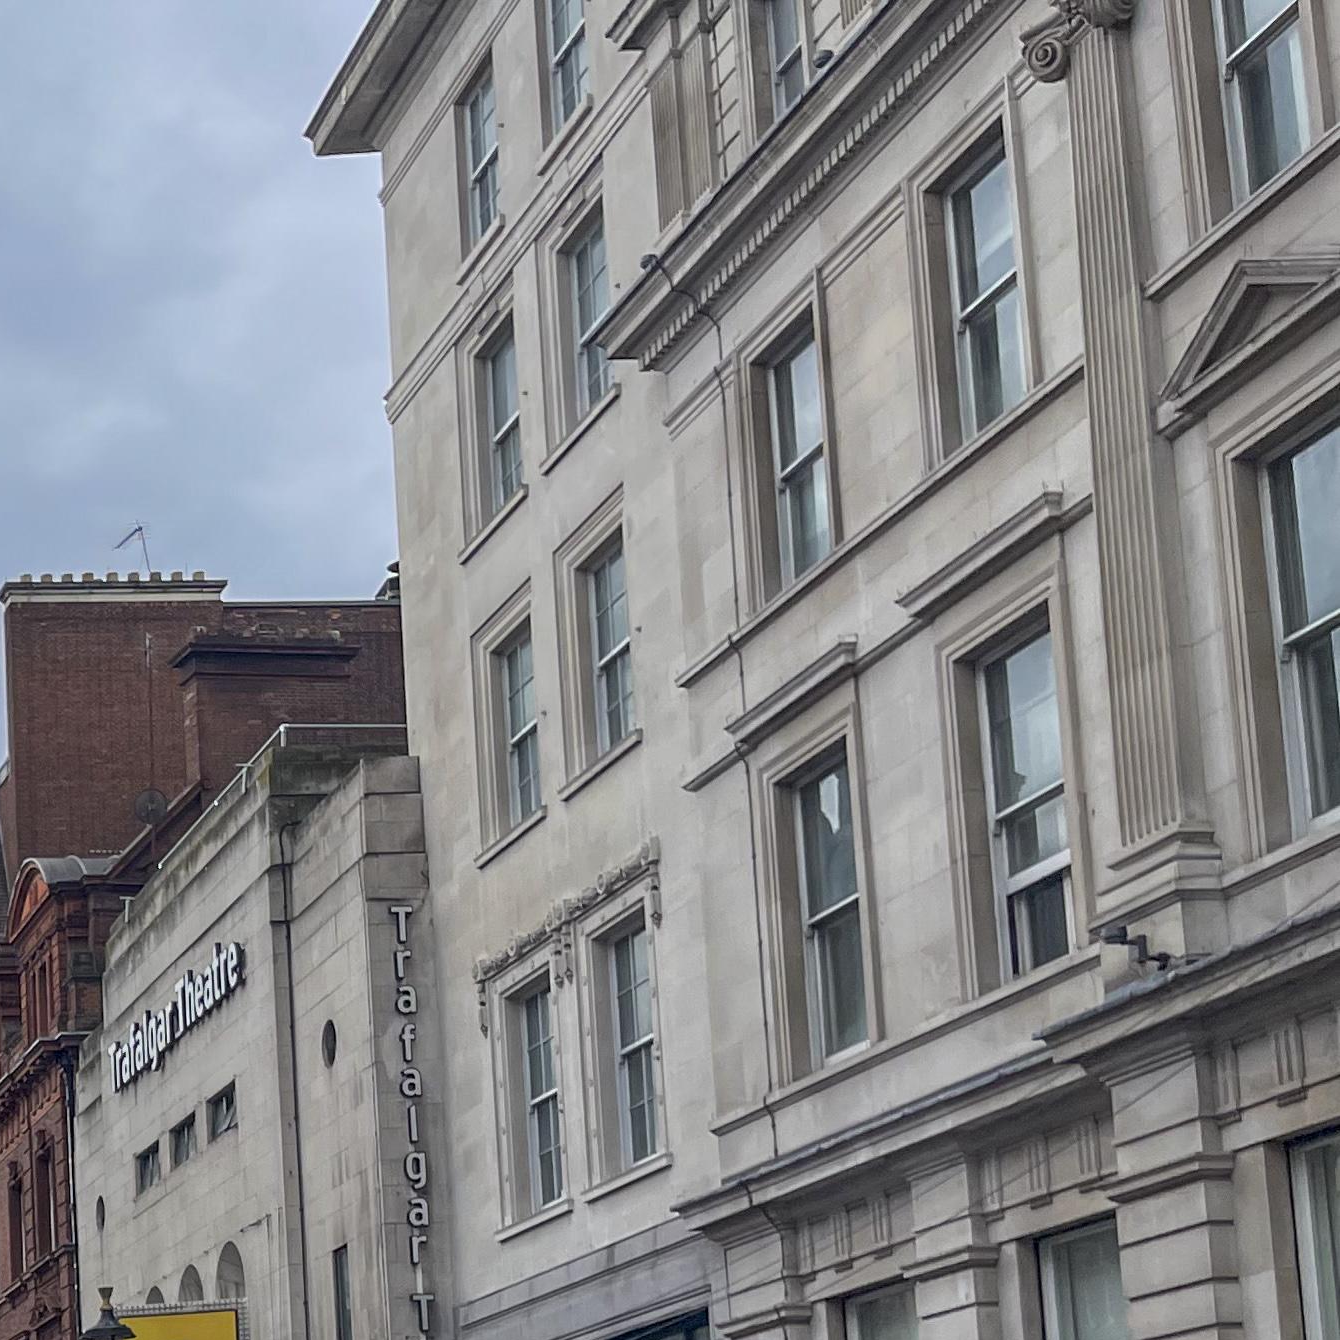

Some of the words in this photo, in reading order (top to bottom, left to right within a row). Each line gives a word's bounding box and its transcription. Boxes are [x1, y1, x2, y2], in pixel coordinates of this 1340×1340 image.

[108, 1001, 172, 1093] Trafalgar
[174, 942, 239, 1038] Theatre
[390, 906, 429, 1265] Trafalgar
